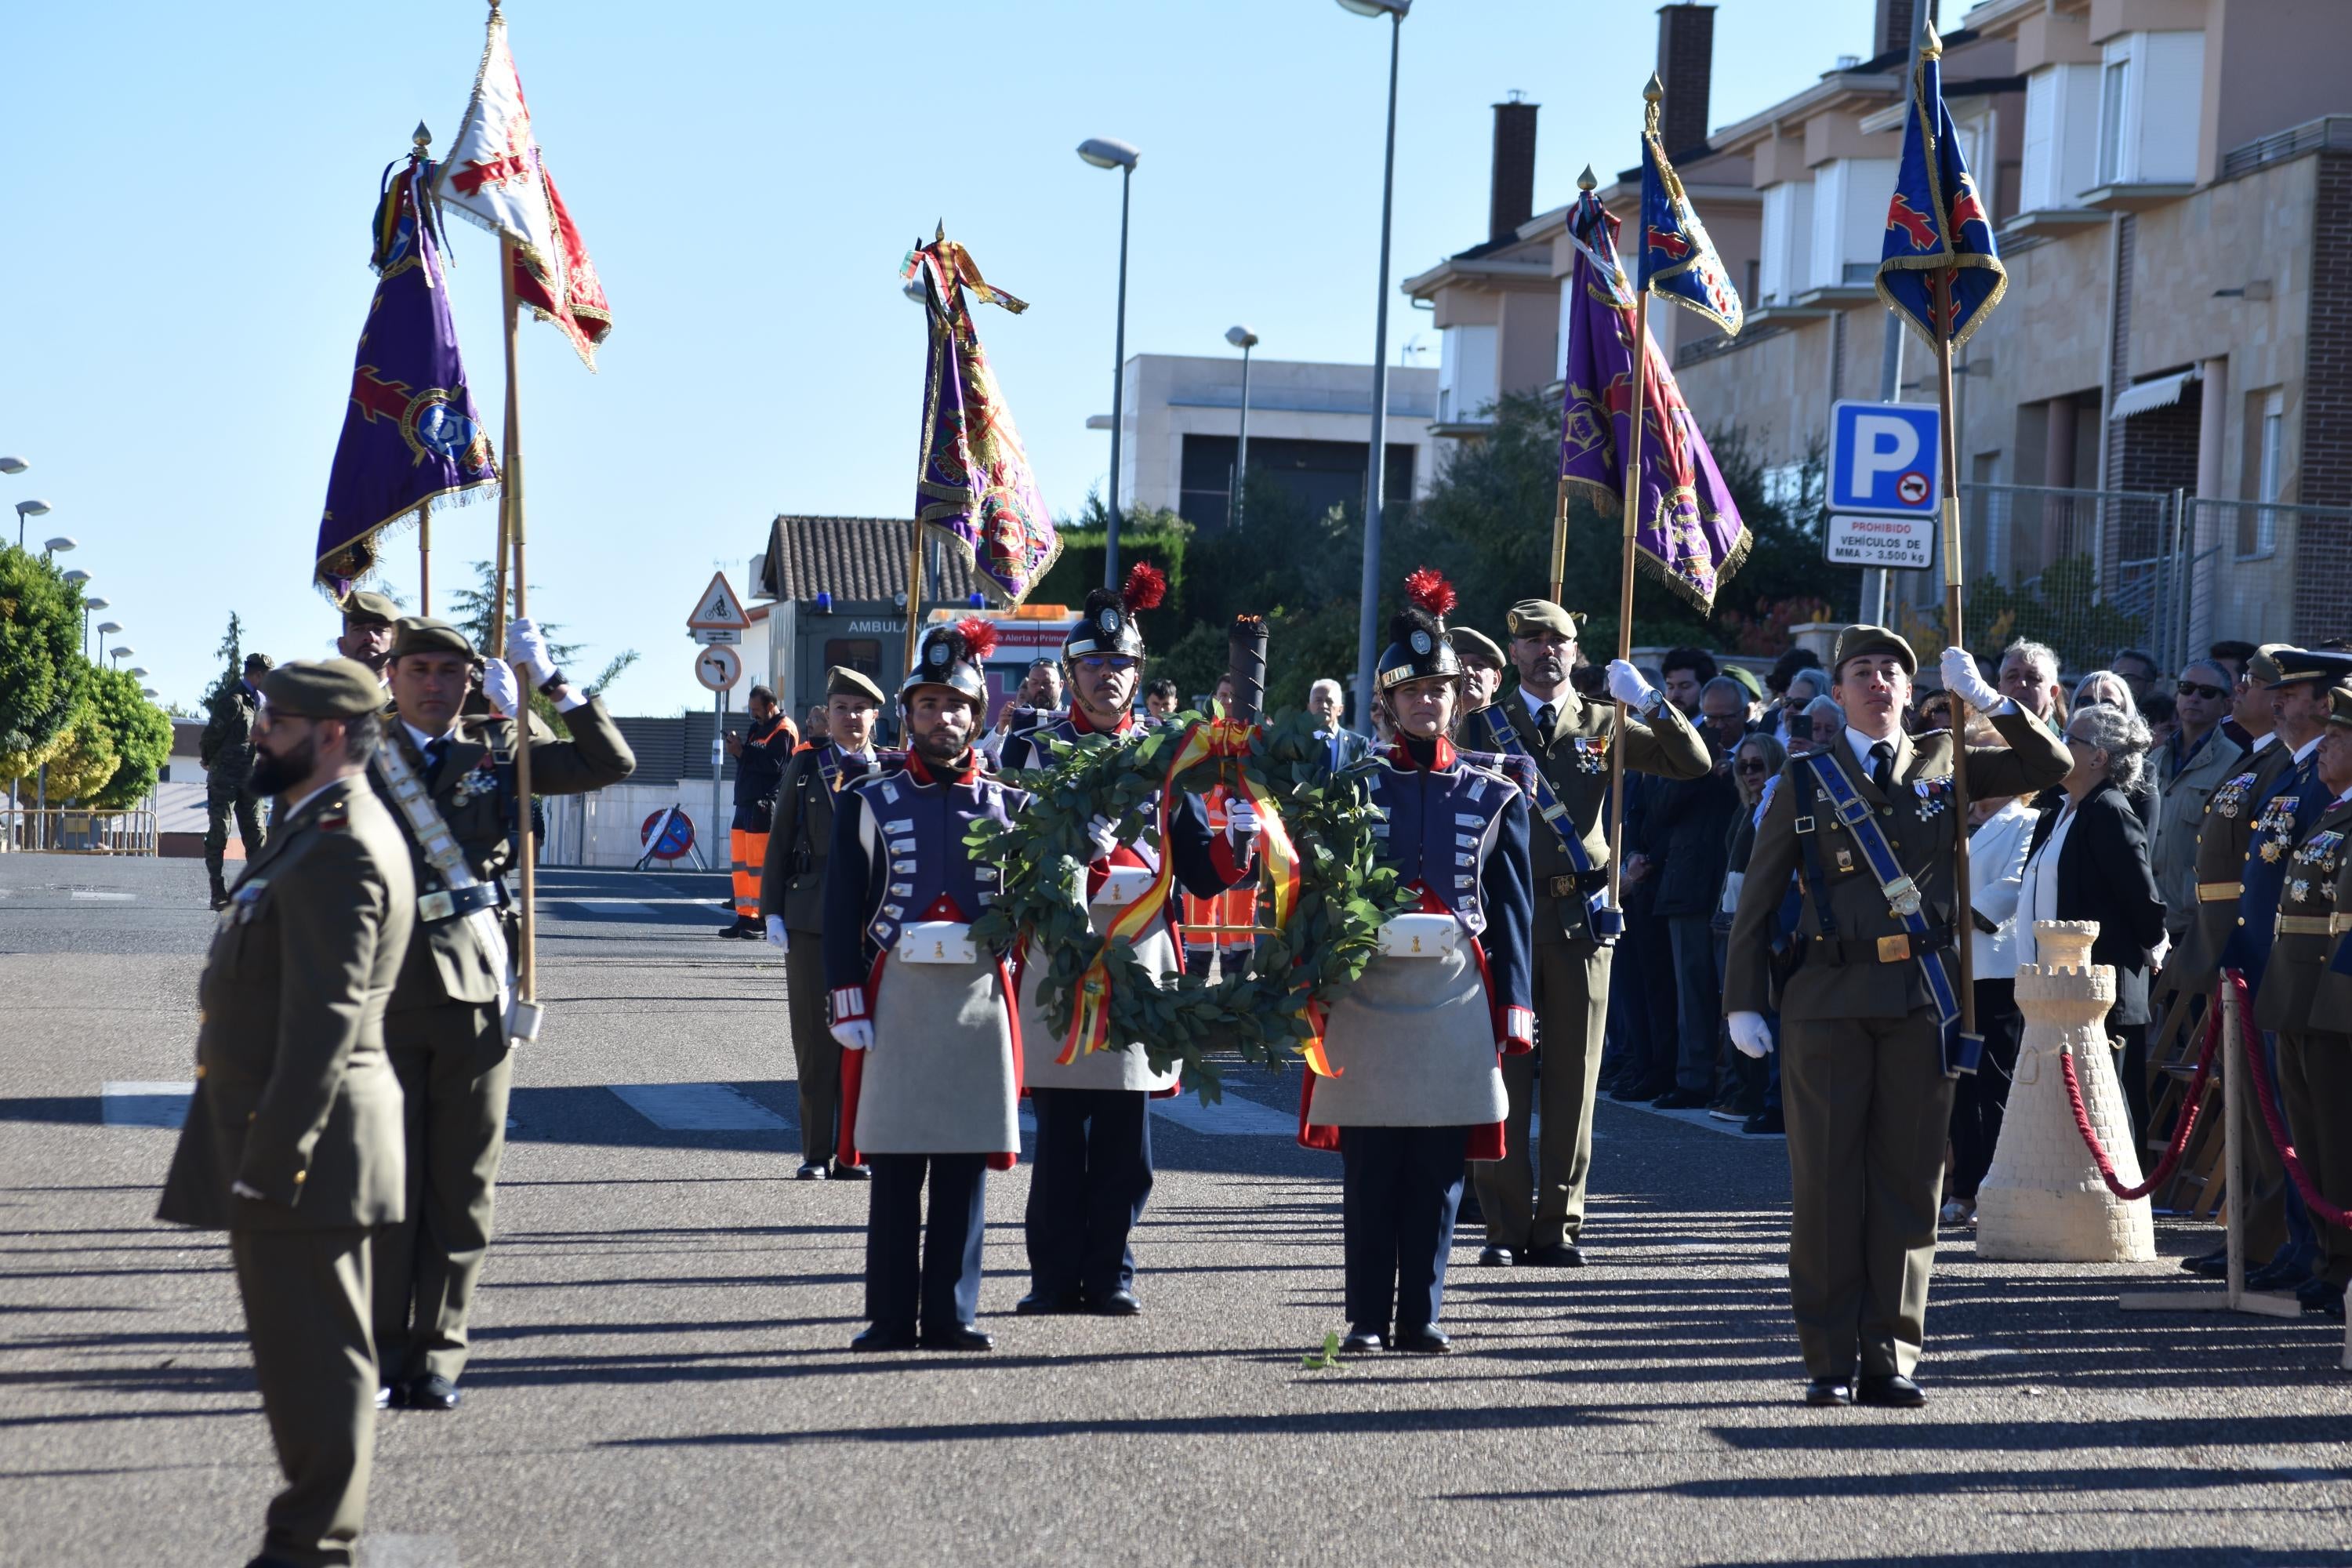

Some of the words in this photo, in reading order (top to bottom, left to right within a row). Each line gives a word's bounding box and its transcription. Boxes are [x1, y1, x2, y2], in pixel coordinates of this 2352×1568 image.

[1851, 414, 1919, 499] P
[1852, 521, 1911, 533] PROHIBIDO
[1841, 535, 1901, 548] VEHÍCULOS
[1907, 539, 1921, 549] DE
[1835, 547, 1861, 557] MMA
[1878, 550, 1907, 561] 3.500
[1911, 553, 1925, 564] kg
